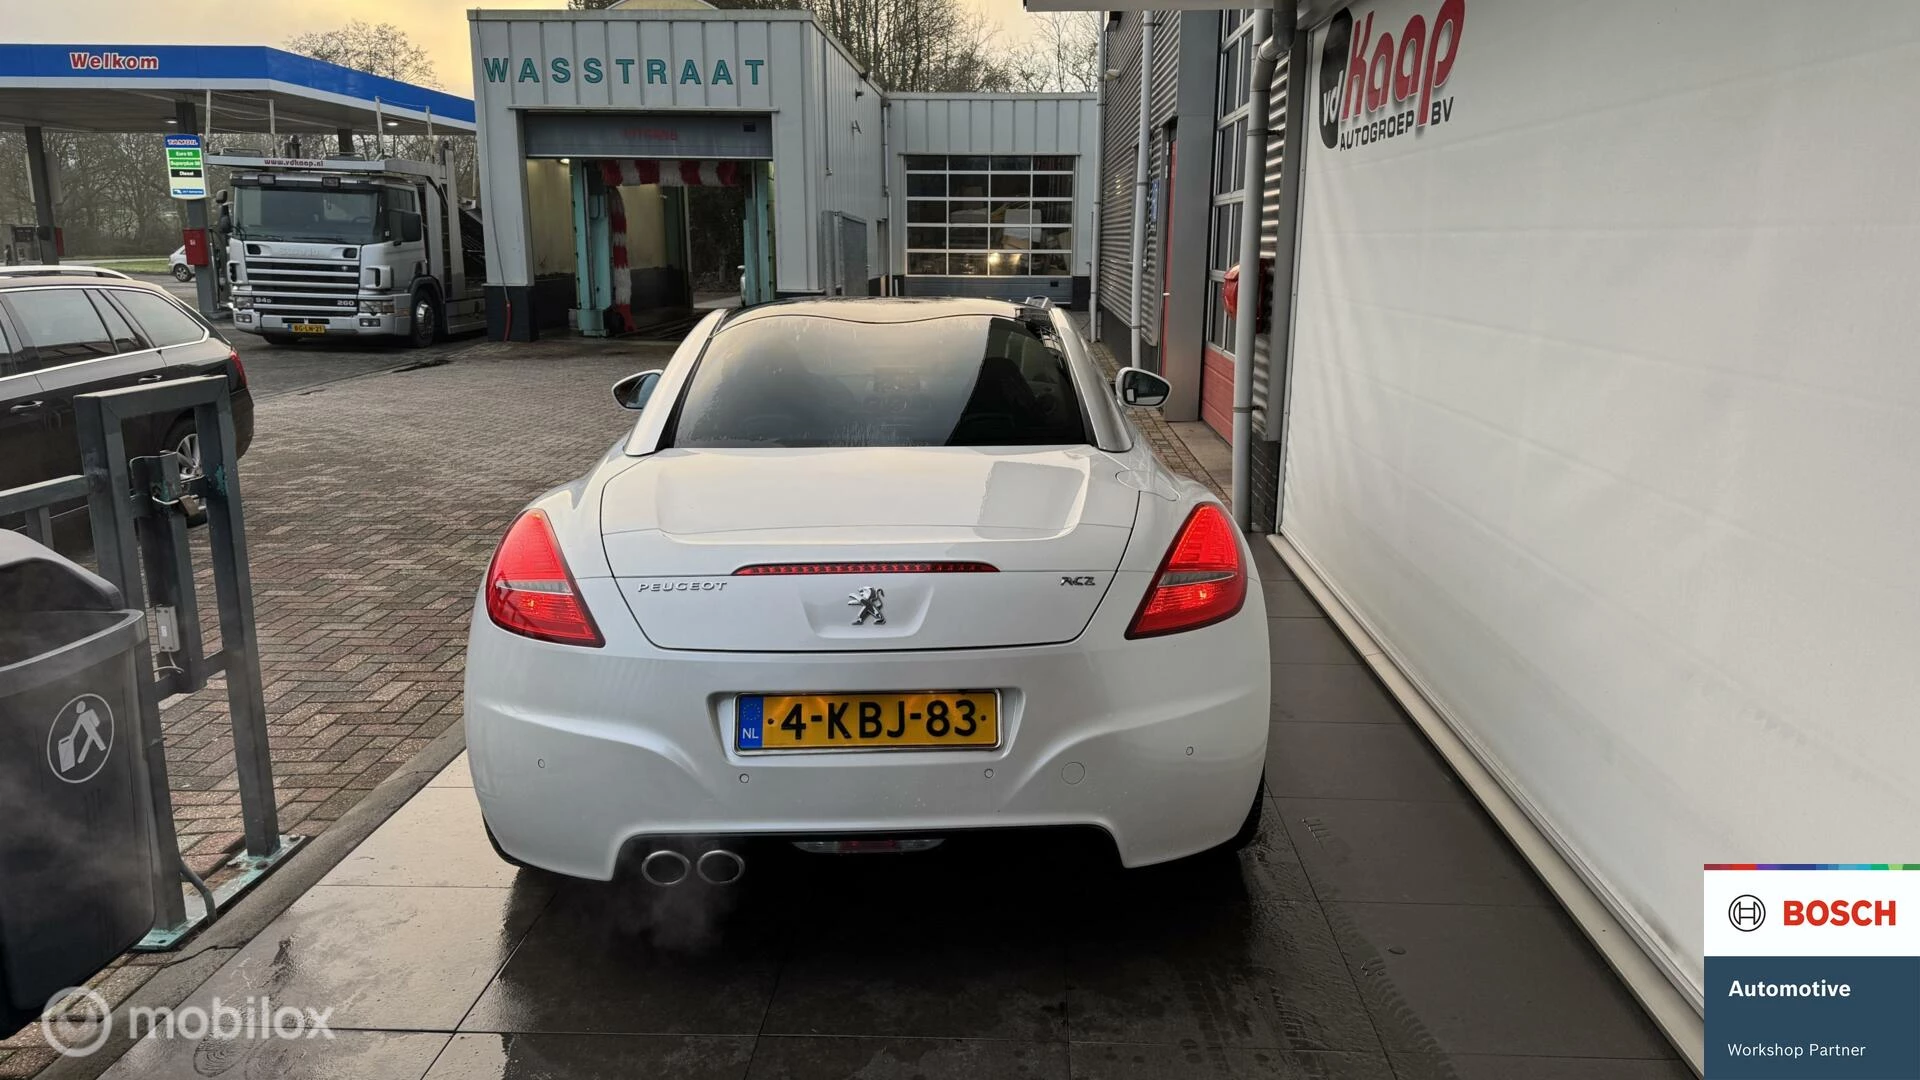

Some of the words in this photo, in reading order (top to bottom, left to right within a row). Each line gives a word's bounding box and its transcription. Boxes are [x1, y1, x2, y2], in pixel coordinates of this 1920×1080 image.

[69, 52, 159, 70] Welkom
[483, 57, 765, 85] WASSTRAAT
[1322, 70, 1344, 126] vd
[1341, 0, 1465, 127] Kaap
[1340, 109, 1415, 151] AUTOGROEP
[1431, 97, 1455, 126] BV
[637, 581, 728, 593] PEUGEOT
[1060, 576, 1096, 586] RCZ
[742, 727, 759, 740] NL
[780, 699, 977, 741] 4-KBJ-83
